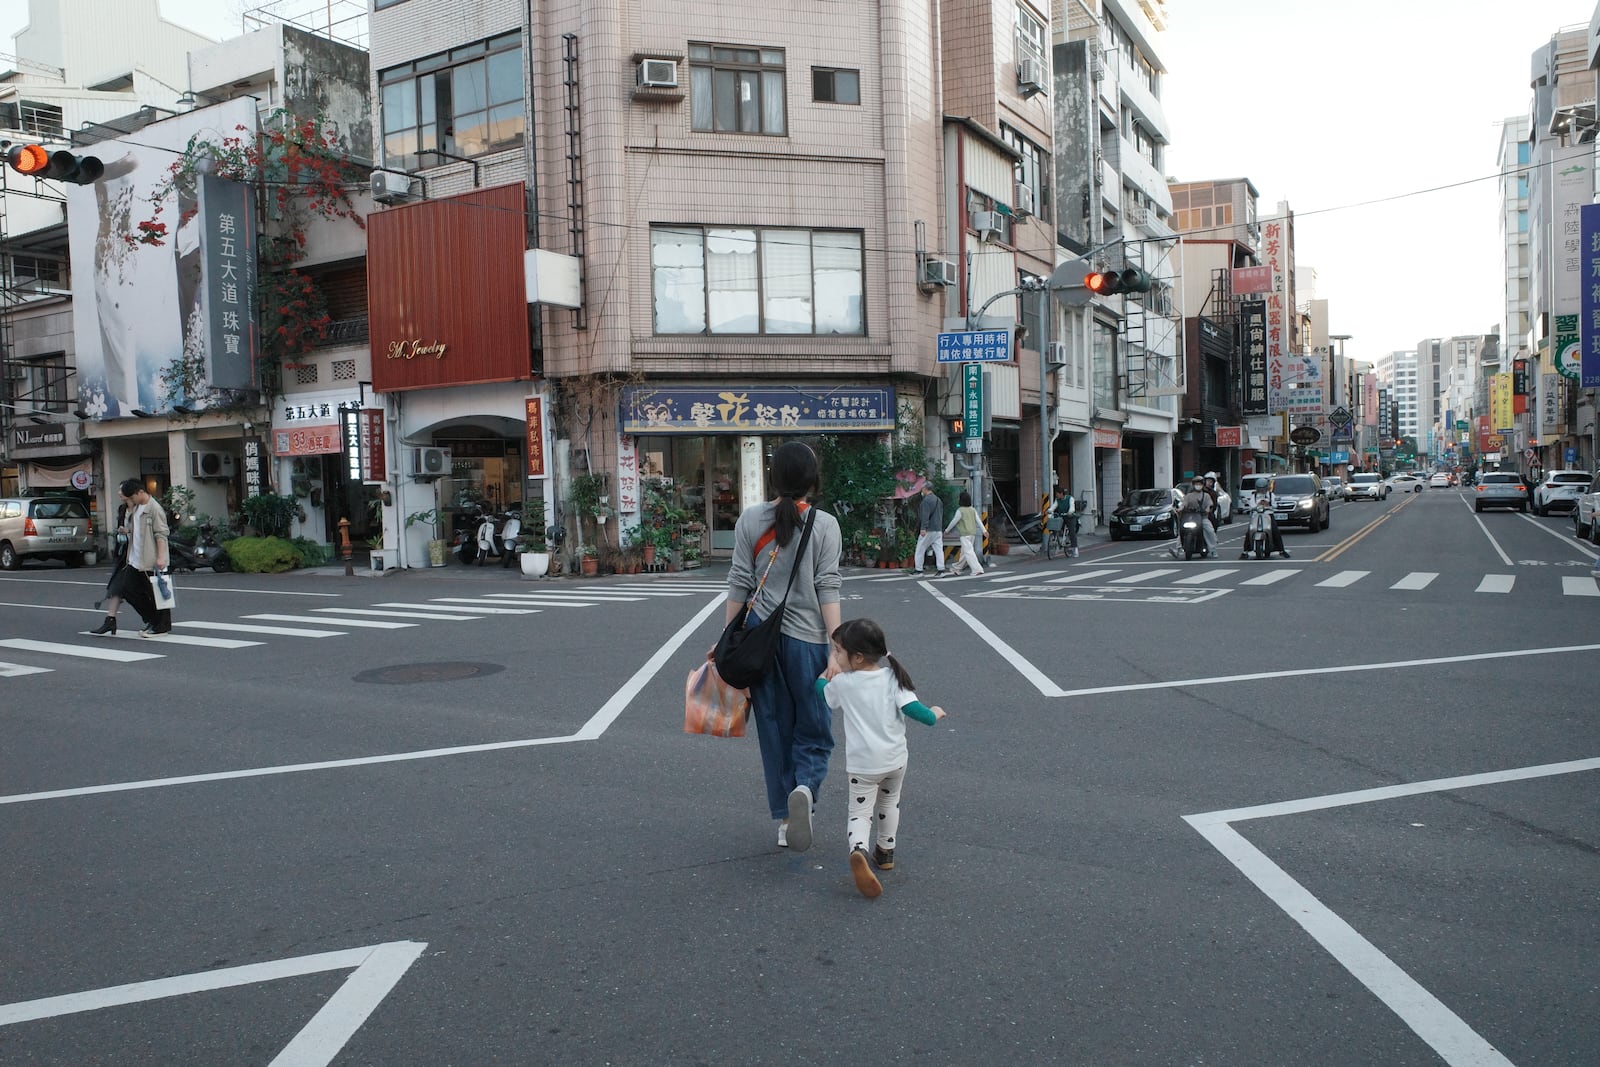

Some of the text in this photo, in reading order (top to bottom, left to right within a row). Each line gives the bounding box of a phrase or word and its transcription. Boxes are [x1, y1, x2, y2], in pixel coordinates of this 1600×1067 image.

[219, 213, 240, 355] 第五大道珠寶
[406, 339, 447, 360] Jewelry
[940, 333, 1007, 348] 行人專用時相
[940, 346, 1007, 360] 請依燈號行駛
[690, 391, 803, 429] 馨花怒放
[968, 390, 979, 437] 永福路二段
